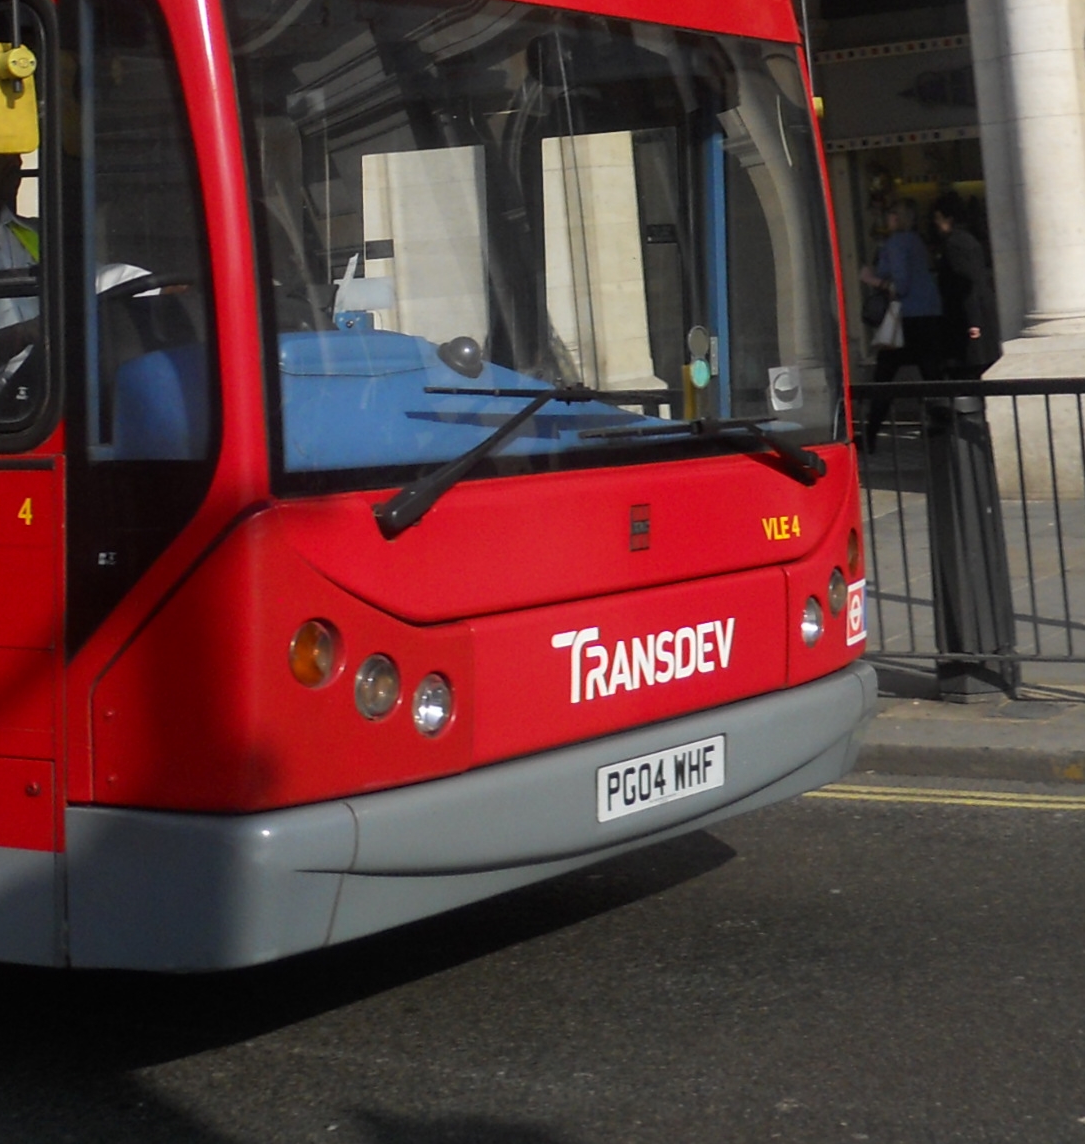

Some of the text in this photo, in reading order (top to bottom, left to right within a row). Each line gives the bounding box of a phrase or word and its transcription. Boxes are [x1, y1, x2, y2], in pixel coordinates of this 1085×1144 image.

[17, 498, 33, 525] 4
[761, 514, 801, 541] VLE 4
[551, 617, 735, 703] TRANSDEV
[607, 745, 714, 811] PG04 WHF
